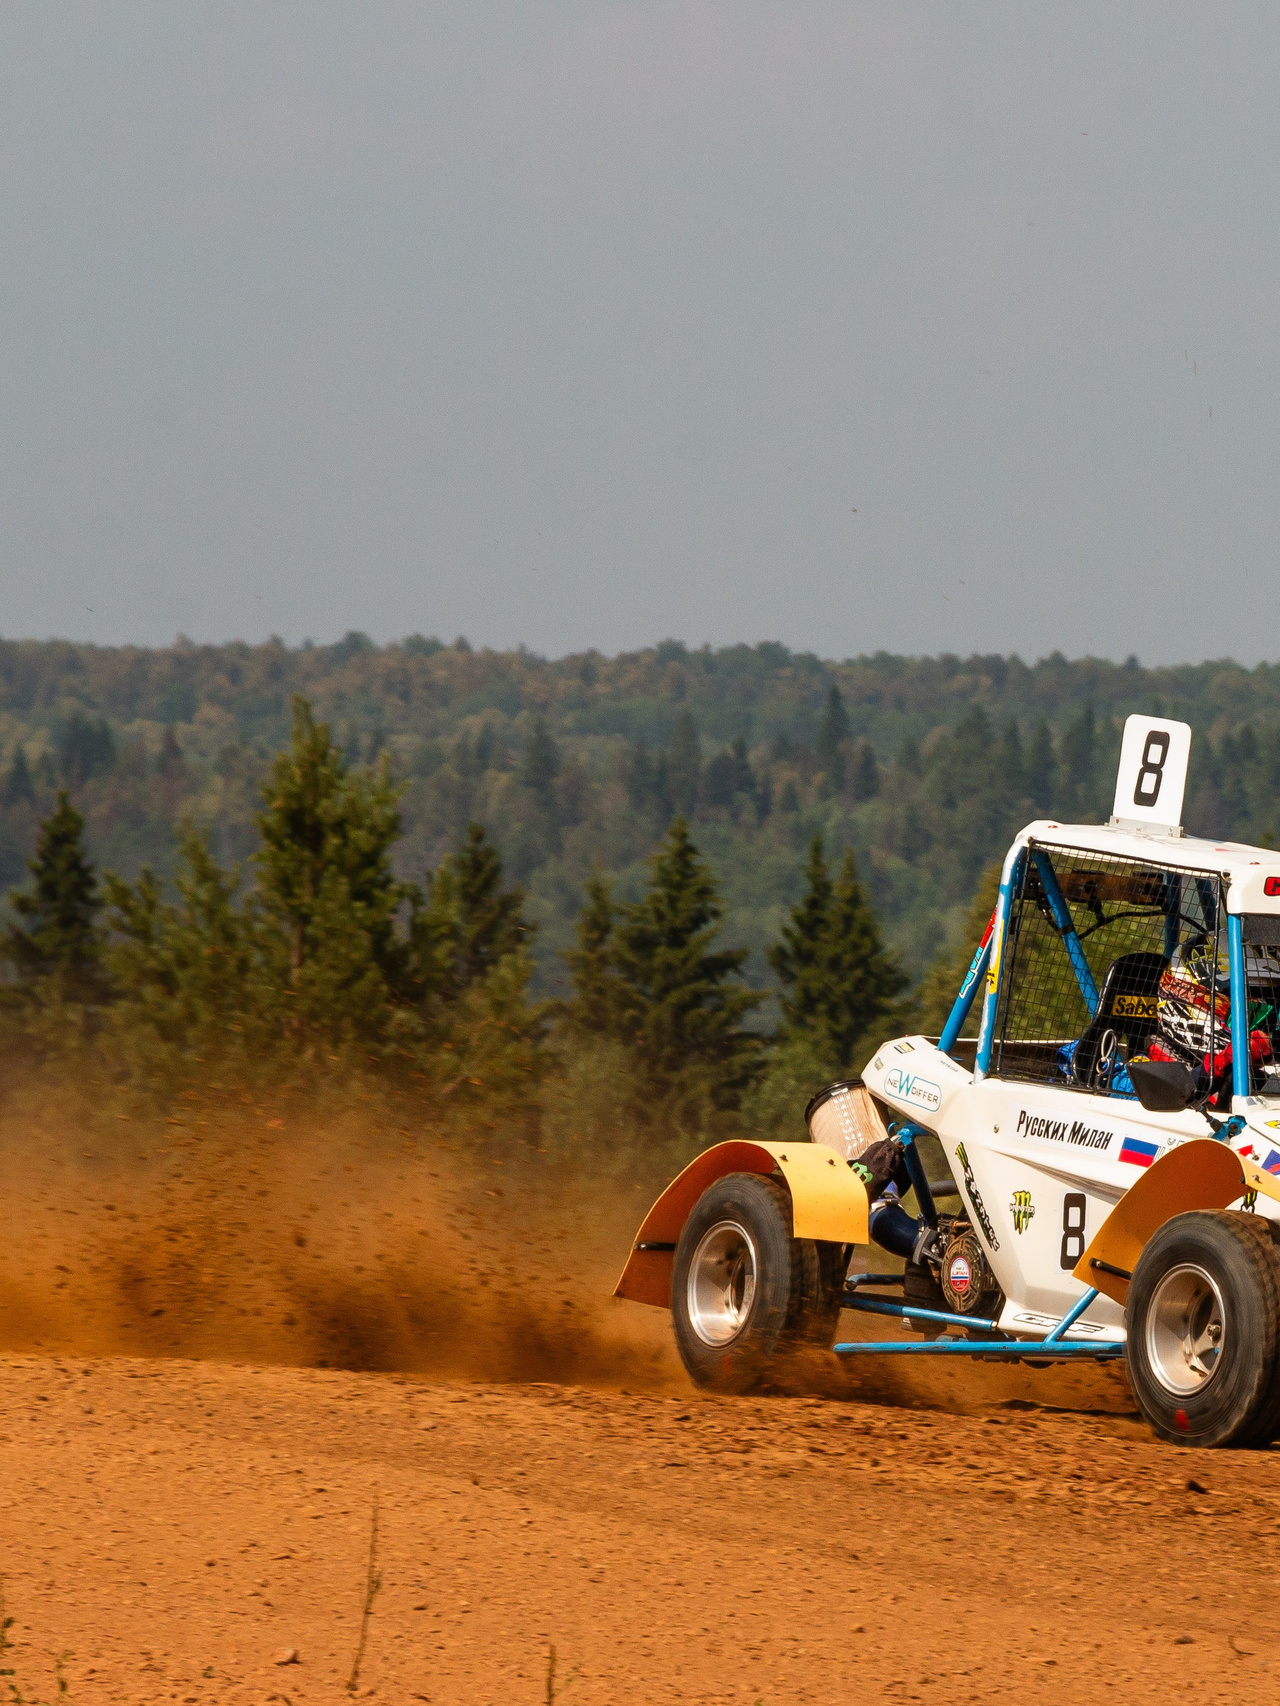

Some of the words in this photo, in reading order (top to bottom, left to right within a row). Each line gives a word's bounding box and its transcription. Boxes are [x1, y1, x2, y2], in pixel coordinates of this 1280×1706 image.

[1133, 730, 1170, 807] 8
[1115, 997, 1158, 1016] Sabe
[1016, 1110, 1069, 1142] Русских
[1066, 1120, 1114, 1150] Милан
[1060, 1193, 1086, 1270] 8
